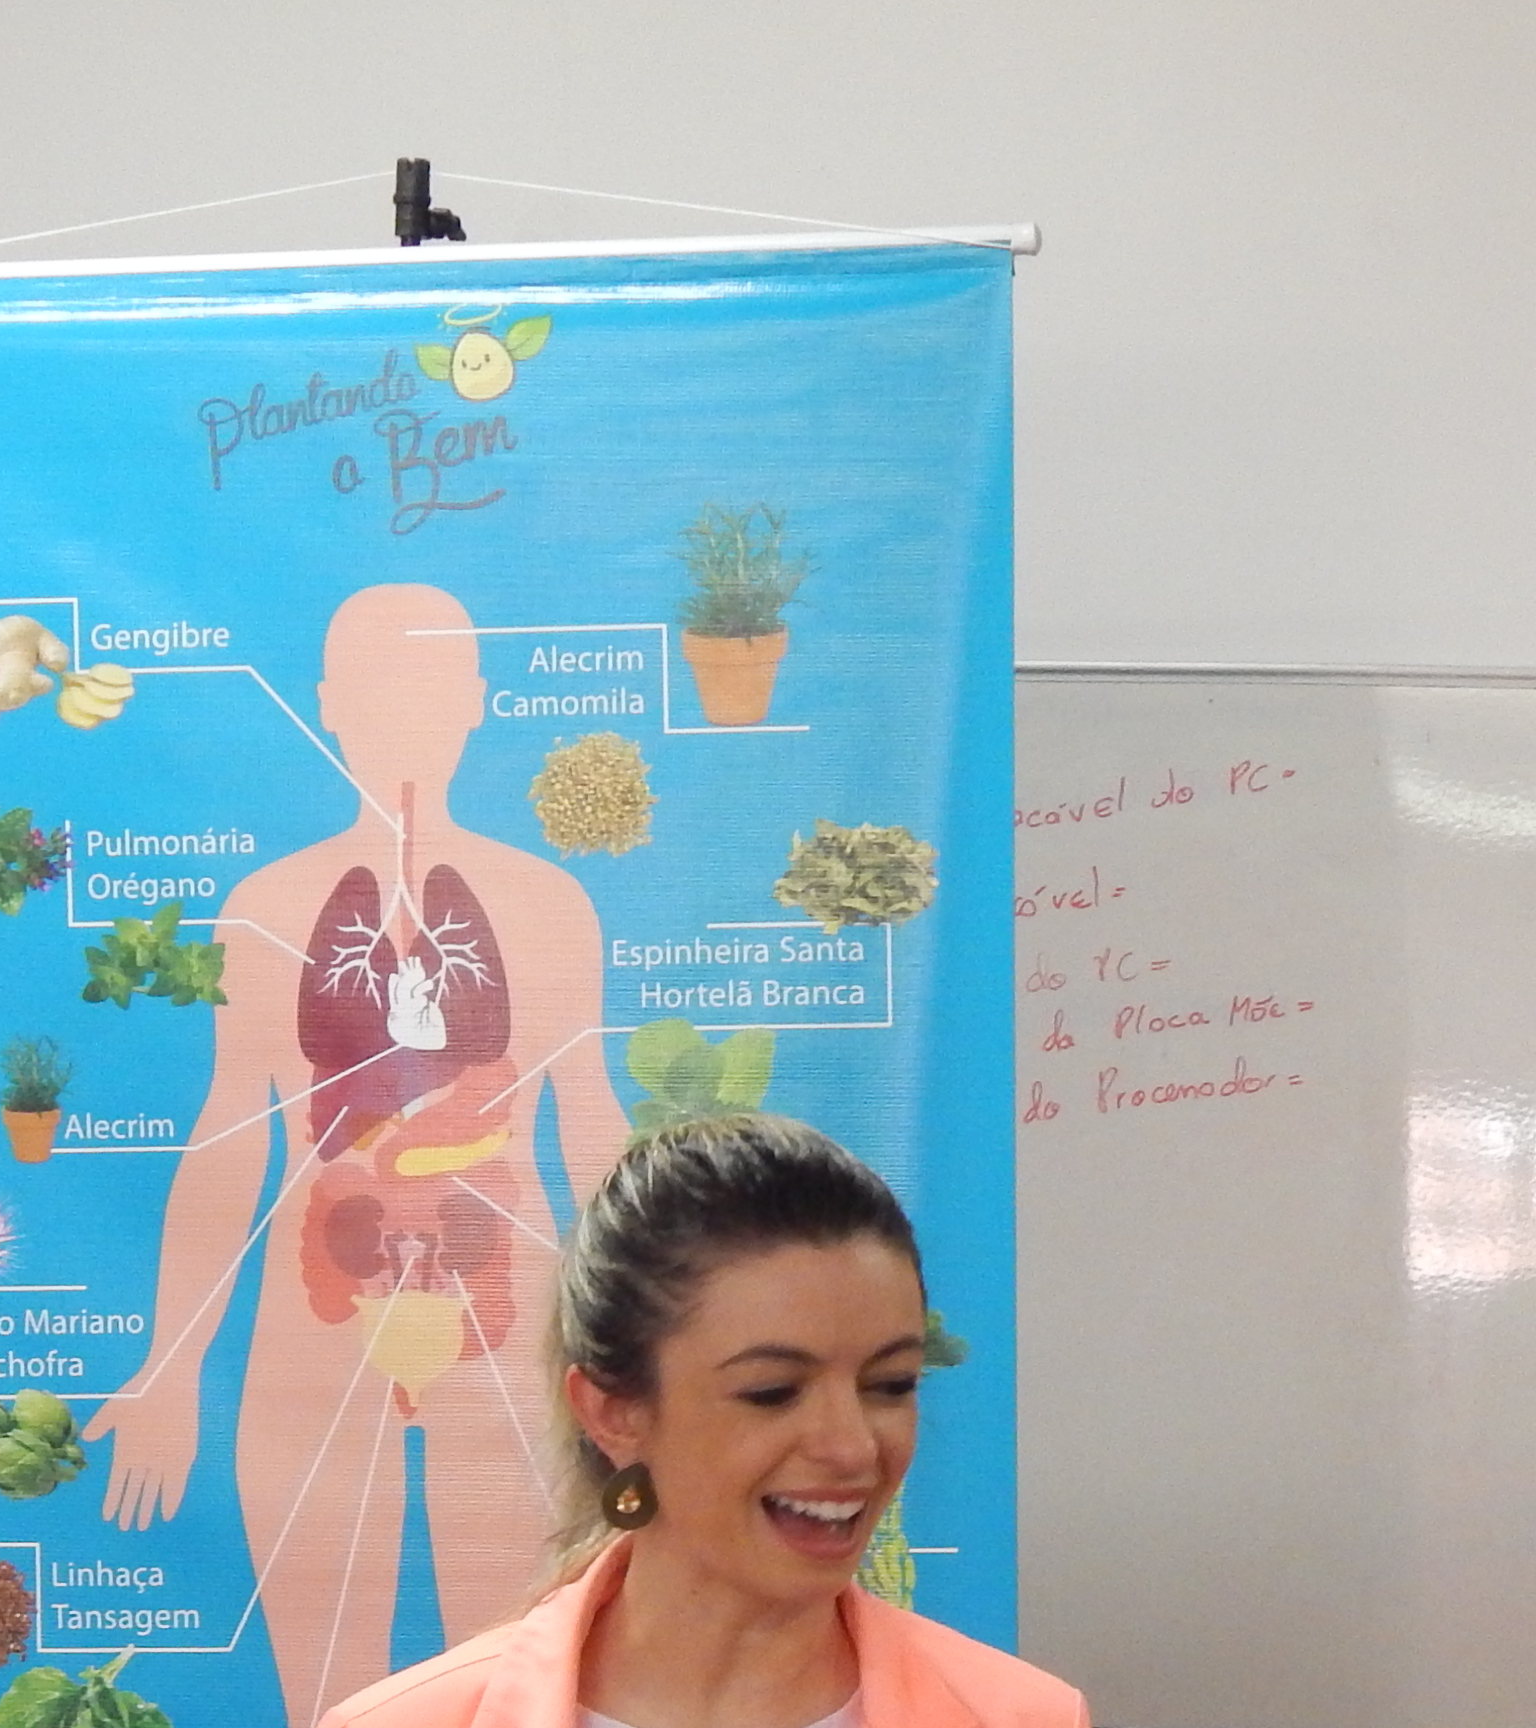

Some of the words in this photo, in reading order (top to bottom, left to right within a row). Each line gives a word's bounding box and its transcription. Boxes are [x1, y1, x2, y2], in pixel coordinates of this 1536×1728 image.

[198, 348, 421, 490] Plantando
[374, 408, 519, 535] Bem
[91, 621, 230, 655] Gengibre
[529, 645, 644, 673] Alecrim
[492, 687, 645, 718] Camomila
[87, 828, 255, 857] Pulmonária
[87, 872, 216, 905] Orégano
[612, 938, 769, 973] Espinheira
[780, 935, 864, 963] Santa
[640, 979, 753, 1010] Hortelã
[764, 980, 865, 1006] Branca
[64, 1112, 176, 1140] Alecrim
[24, 1309, 144, 1336] Mariano
[52, 1560, 164, 1594] Linhaça
[51, 1604, 200, 1636] Tansagem
